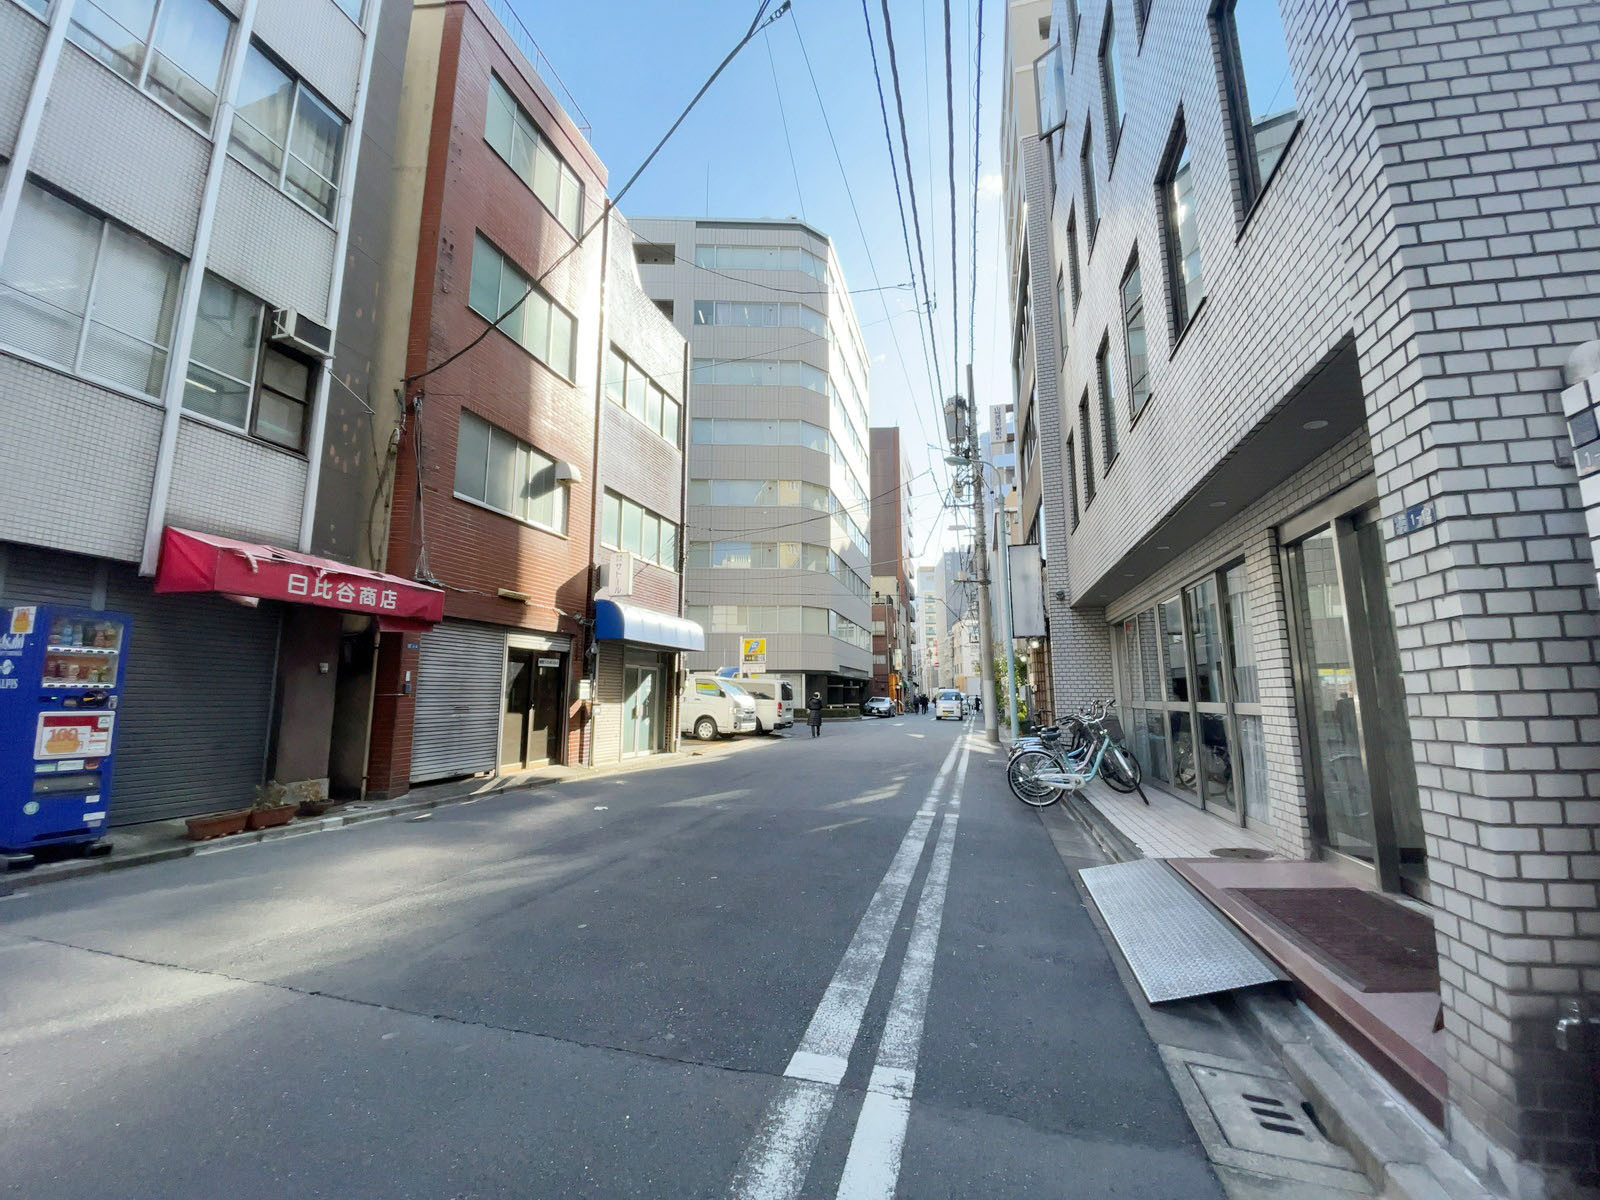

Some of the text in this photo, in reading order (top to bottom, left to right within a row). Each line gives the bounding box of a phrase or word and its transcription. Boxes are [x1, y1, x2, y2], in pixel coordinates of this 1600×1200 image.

[288, 573, 398, 609] 日比谷商店
